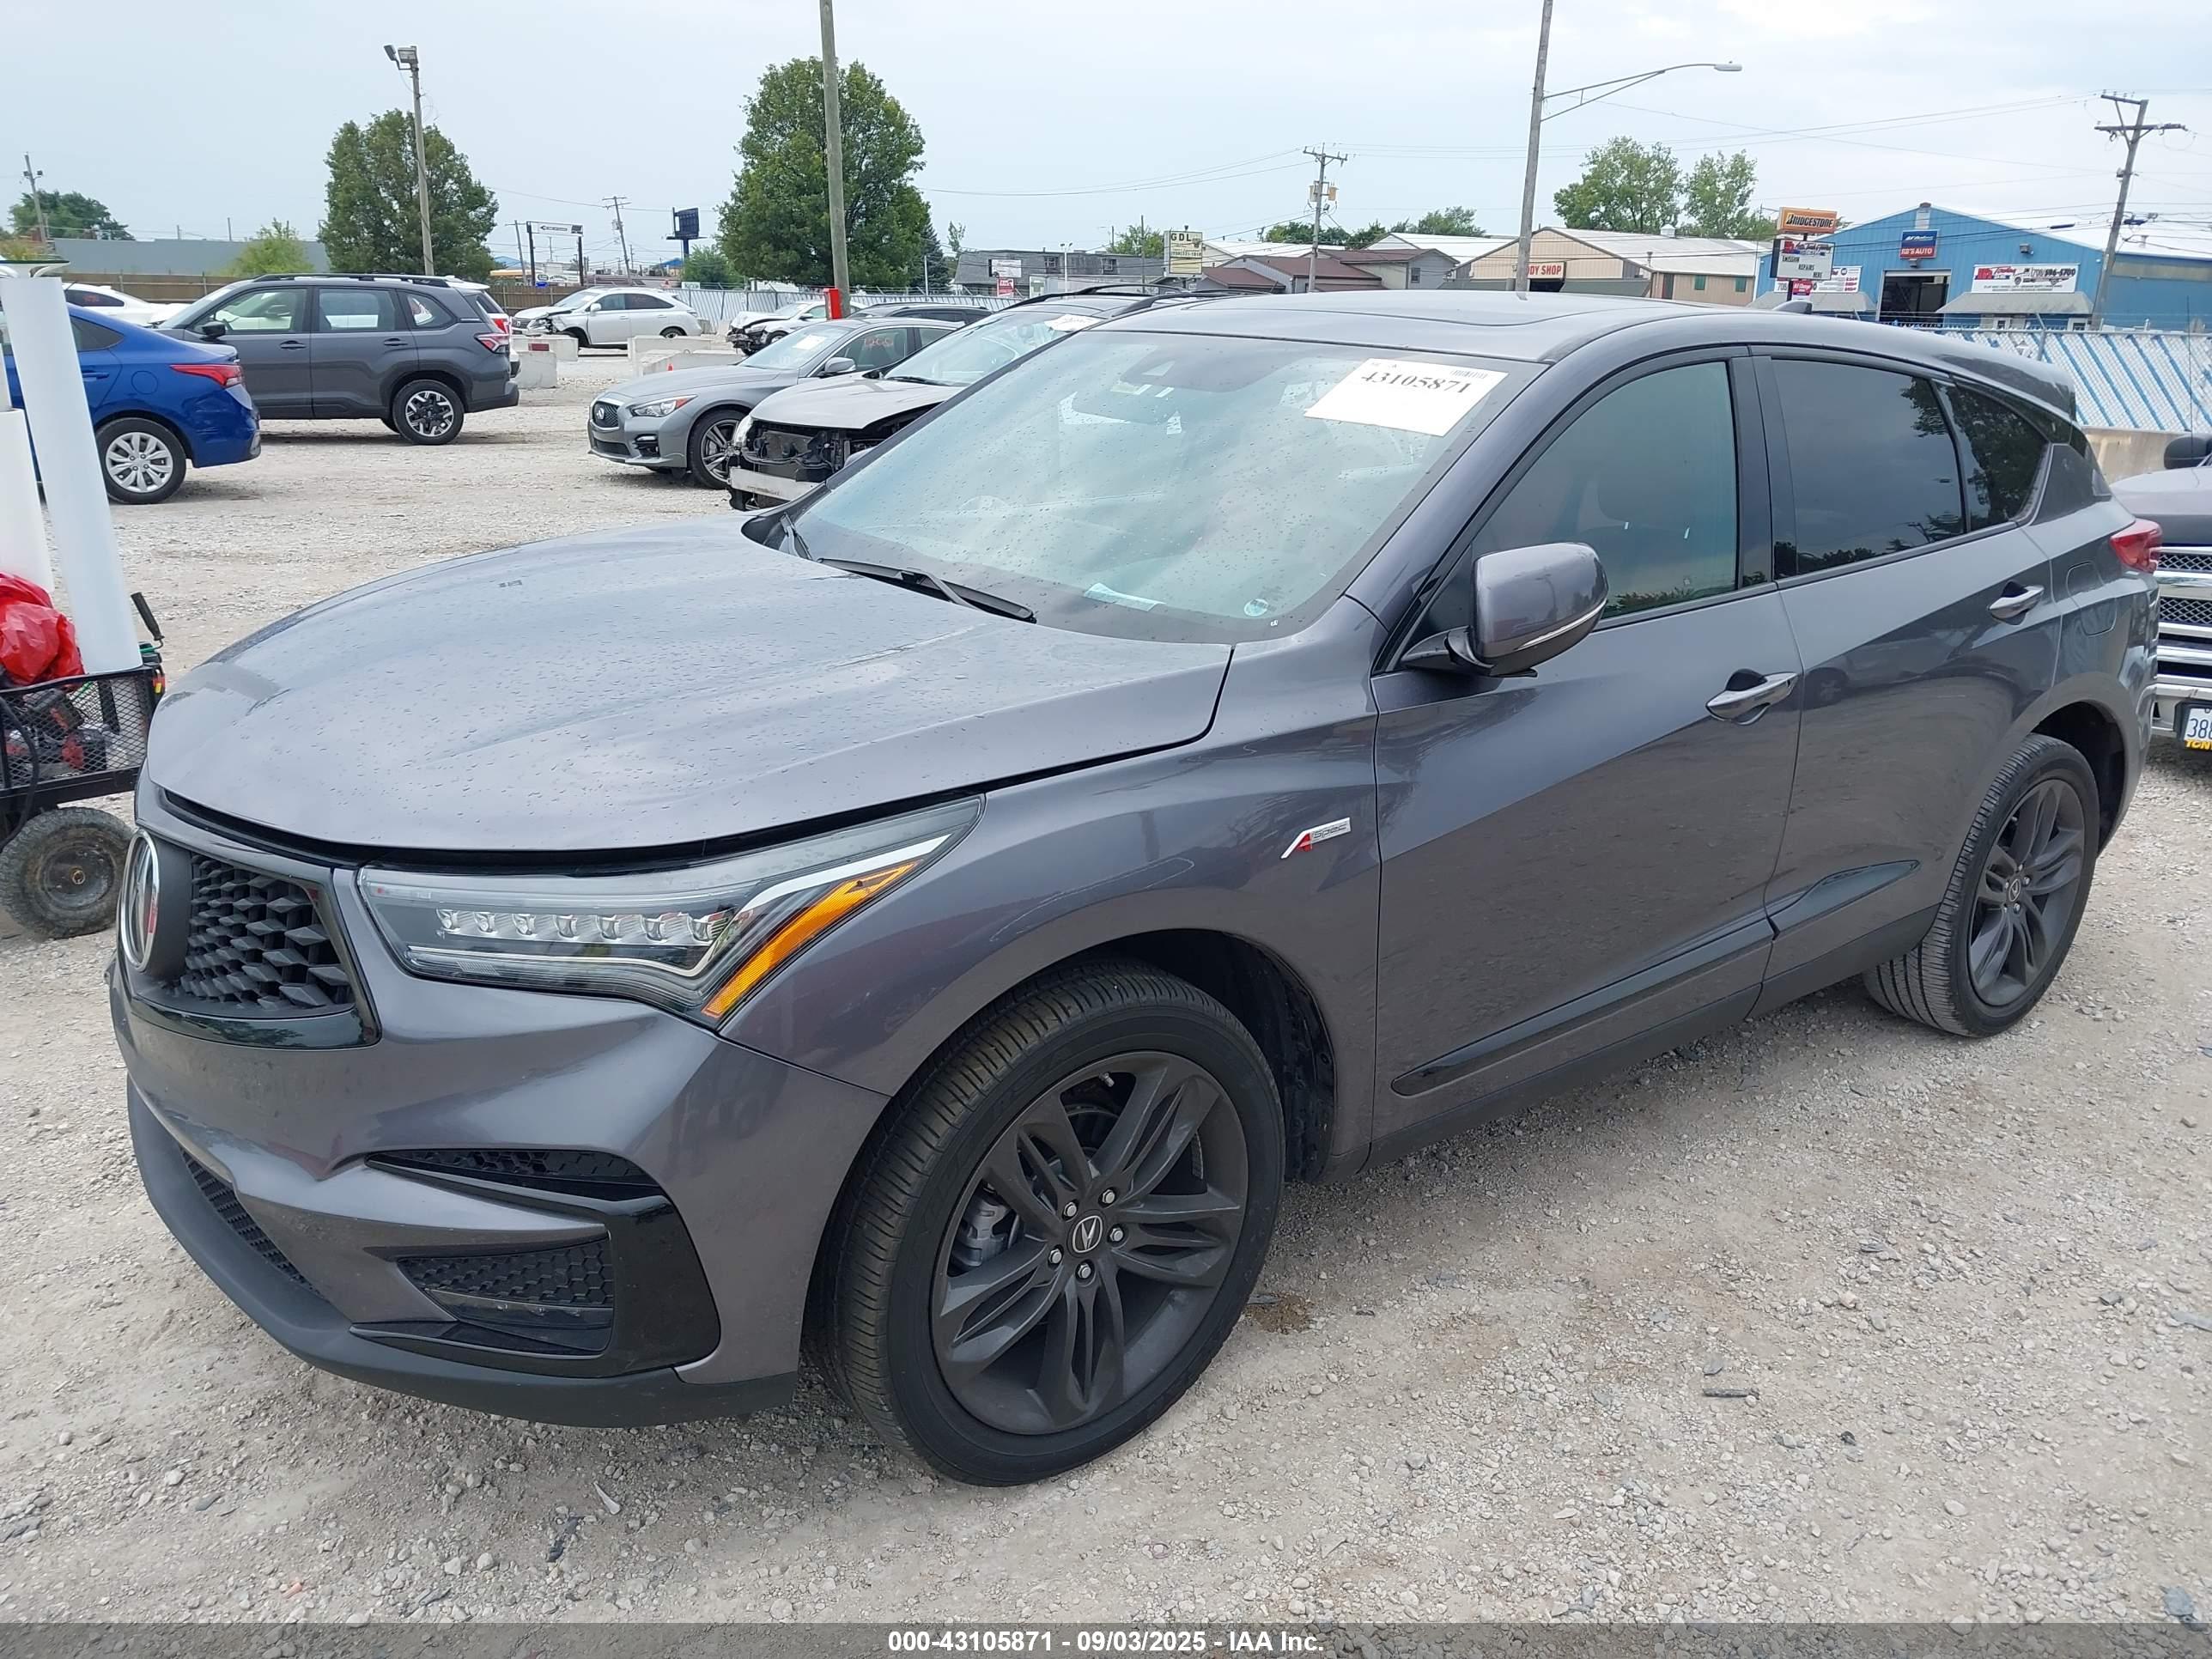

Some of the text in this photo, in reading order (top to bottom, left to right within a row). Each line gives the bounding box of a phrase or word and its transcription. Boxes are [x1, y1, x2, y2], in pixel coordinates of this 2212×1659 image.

[1786, 214, 1834, 228] BRIDGESTONE
[1170, 233, 1192, 241] GDL
[1525, 264, 1562, 276] ODY SHOP
[1361, 371, 1471, 393] 43105871
[2186, 740, 2212, 750] TON
